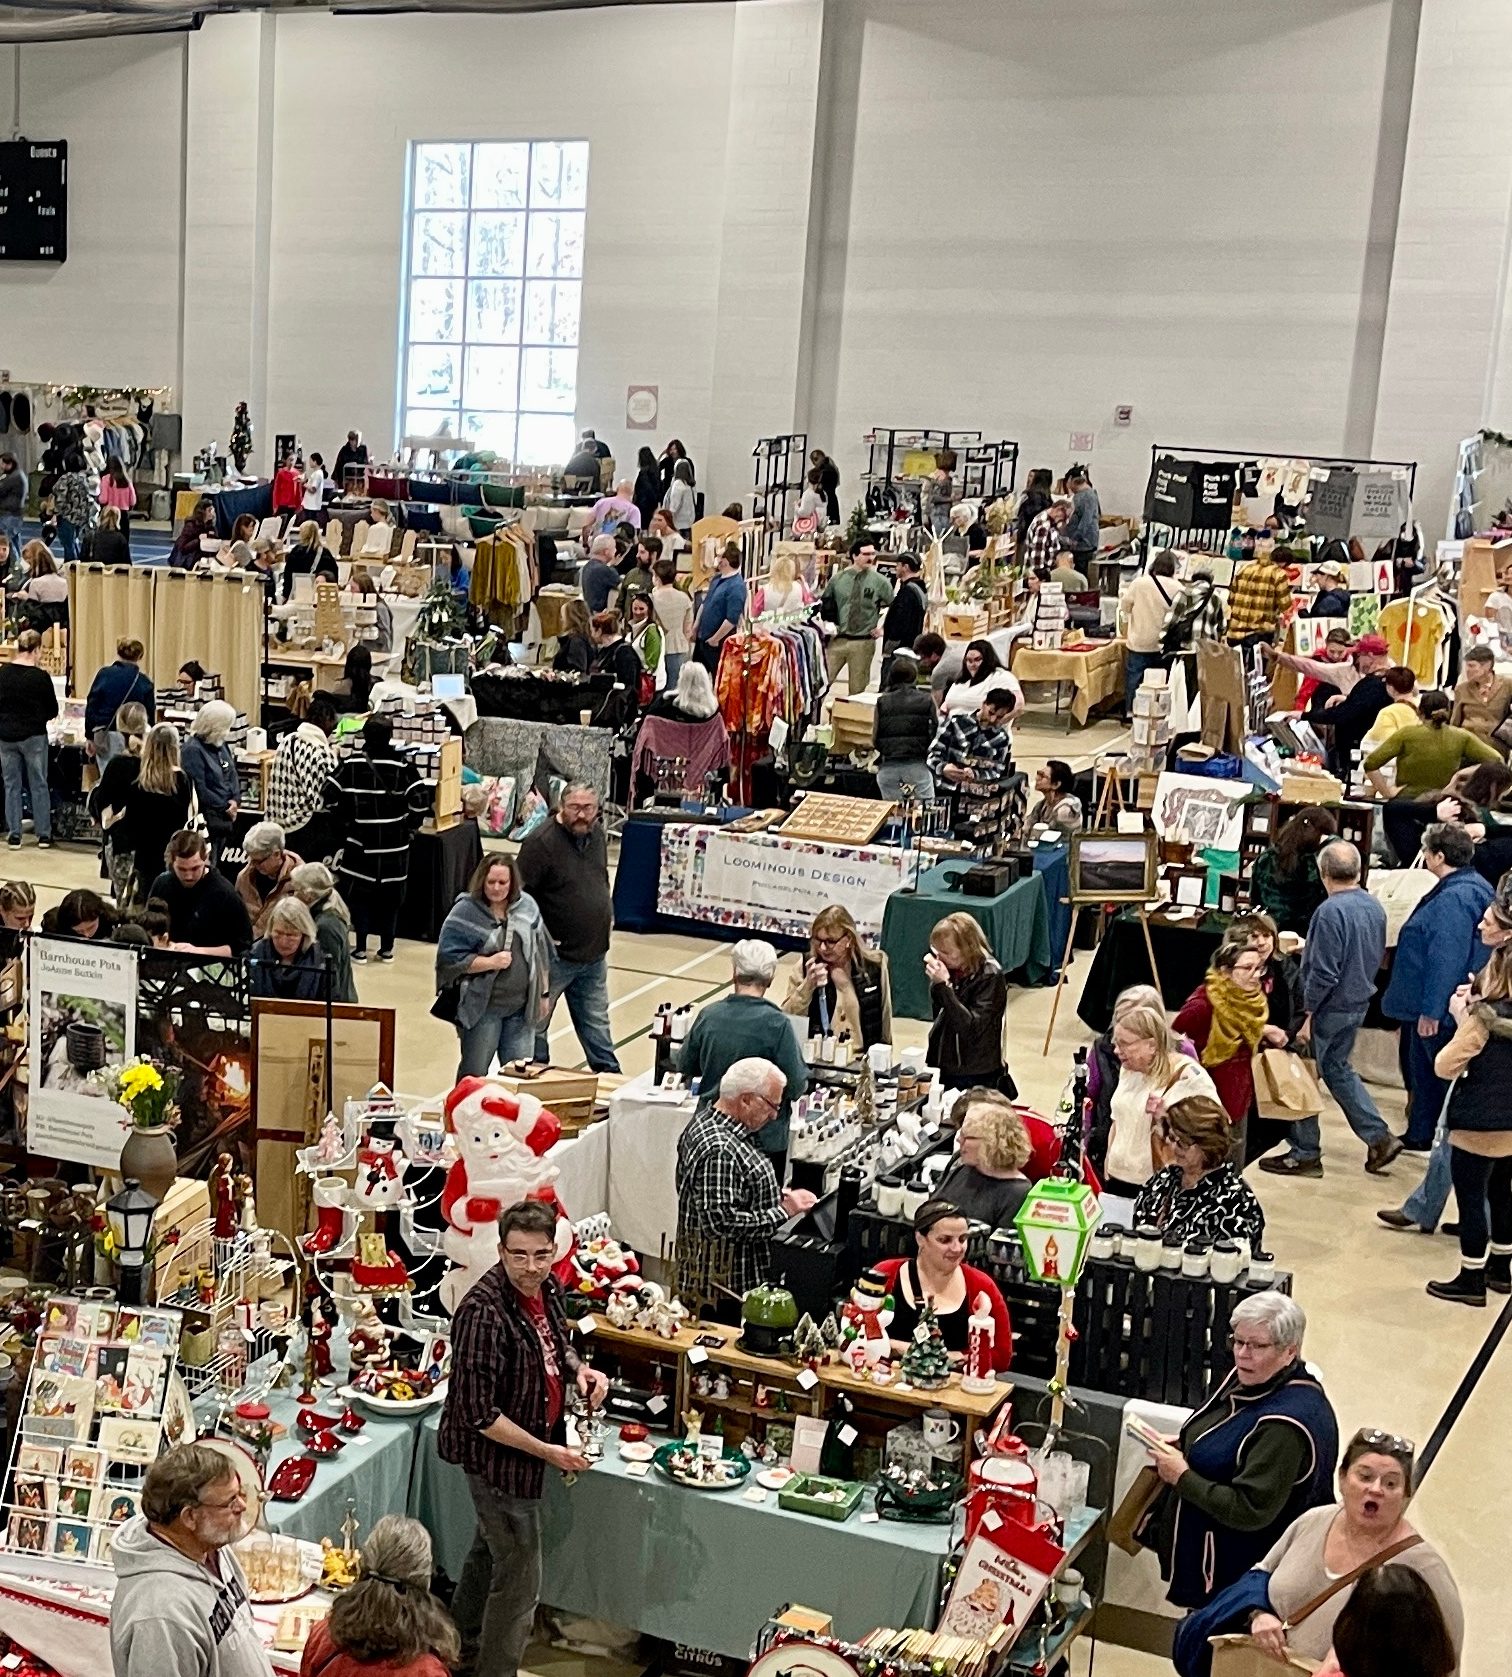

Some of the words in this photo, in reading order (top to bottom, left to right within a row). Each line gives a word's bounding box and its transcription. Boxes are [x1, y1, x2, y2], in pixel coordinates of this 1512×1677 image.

[811, 869, 867, 887] DESIGN
[39, 949, 97, 968] Barnhouse
[99, 958, 122, 972] Pots
[674, 1649, 723, 1667] CITRUS
